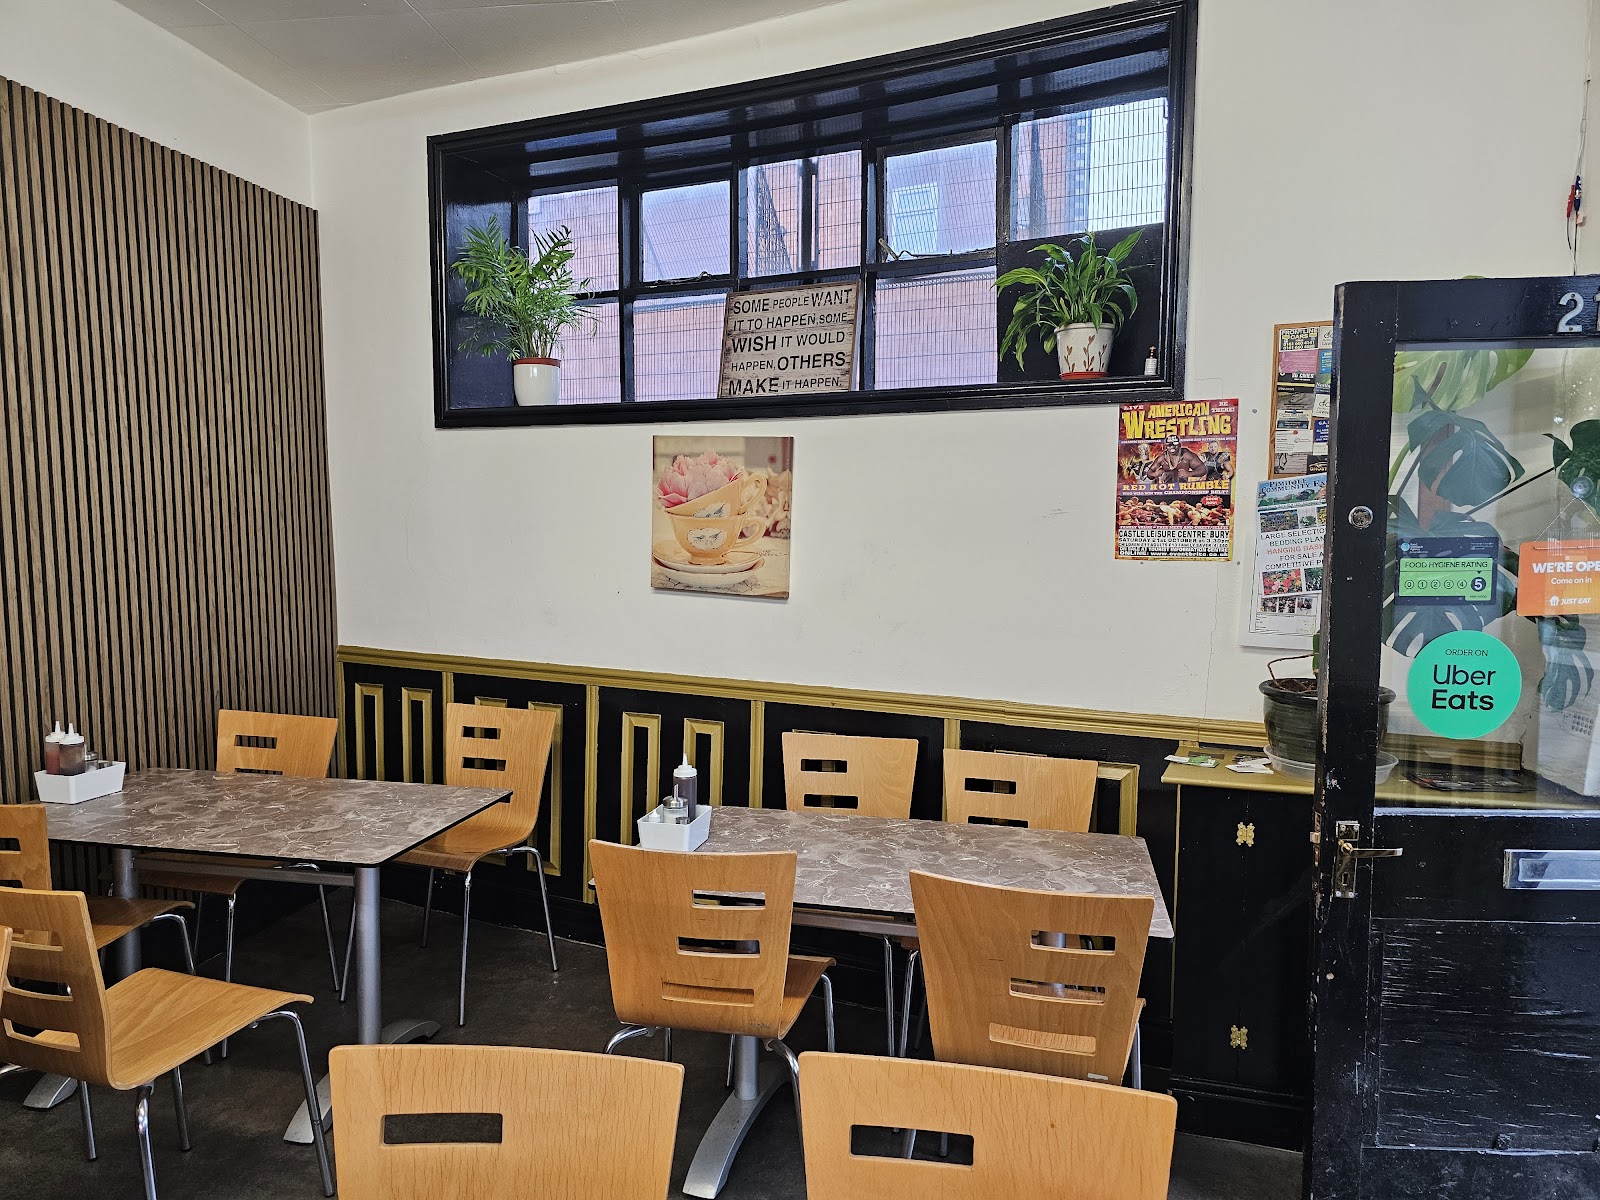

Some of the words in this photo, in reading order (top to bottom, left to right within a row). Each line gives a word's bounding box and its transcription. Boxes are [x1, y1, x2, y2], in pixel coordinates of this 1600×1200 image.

[733, 298, 770, 314] SOME
[772, 296, 810, 309] PEOPLE
[811, 288, 852, 307] WANT
[733, 319, 744, 331] IT
[747, 318, 763, 330] TO
[819, 312, 848, 325] SOME
[732, 335, 777, 353] WISH
[781, 336, 793, 347] IT
[796, 331, 845, 347] WOULD
[777, 352, 846, 371] OTHERS
[728, 377, 780, 396] MAKE
[782, 380, 791, 389] IT
[1148, 402, 1210, 418] AMERICAN
[1122, 410, 1232, 439] WRESTLING
[1150, 483, 1175, 491] HOT
[1180, 480, 1230, 490] RUMBLE
[1261, 483, 1310, 493] COMMUNITY
[1269, 478, 1307, 488] PIMHOLE
[1119, 530, 1145, 538] CASTLE
[1146, 530, 1175, 538] LEISURE
[1178, 530, 1206, 538] CENTRE
[1210, 530, 1229, 538] BURY
[1261, 531, 1286, 540] LARGE
[1288, 528, 1325, 537] SELECTIO
[1270, 538, 1303, 547] BEDDING
[1267, 546, 1301, 554] HANGING
[1265, 560, 1314, 570] COMPETITIVE
[1532, 562, 1573, 574] WE'RE
[1576, 560, 1600, 573] OPE
[1474, 578, 1483, 590] 5
[1551, 577, 1571, 585] Come
[1445, 649, 1473, 657] ORDER
[1474, 649, 1488, 657] ON
[1433, 664, 1496, 686] Uber
[1431, 689, 1495, 710] Eats
